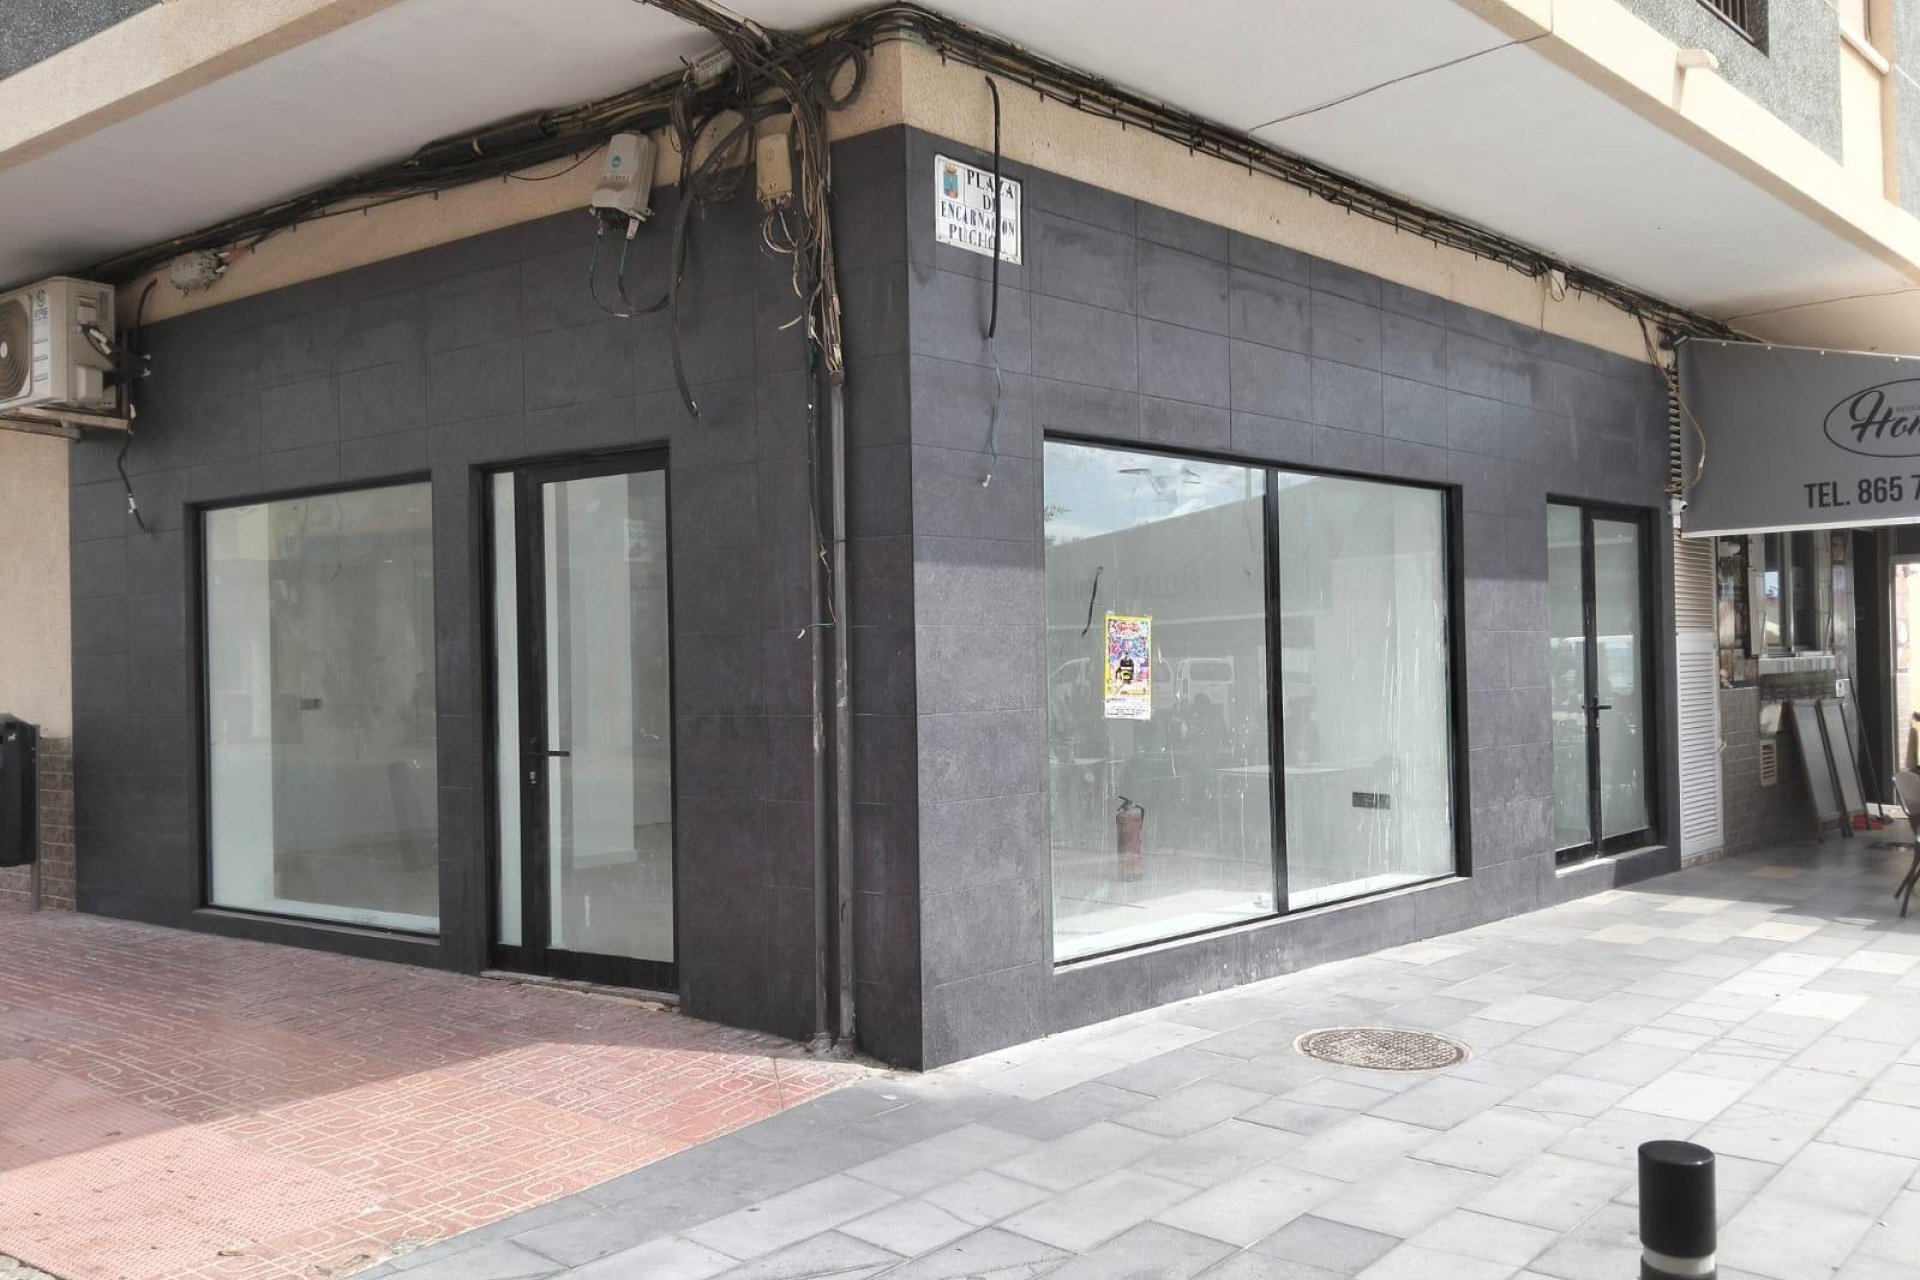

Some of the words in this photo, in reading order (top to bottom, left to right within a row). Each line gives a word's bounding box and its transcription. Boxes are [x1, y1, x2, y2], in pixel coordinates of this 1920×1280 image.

[949, 223, 1003, 250] PUCHO
[1804, 481, 1851, 509] TEL.
[1857, 477, 1903, 505] 865
